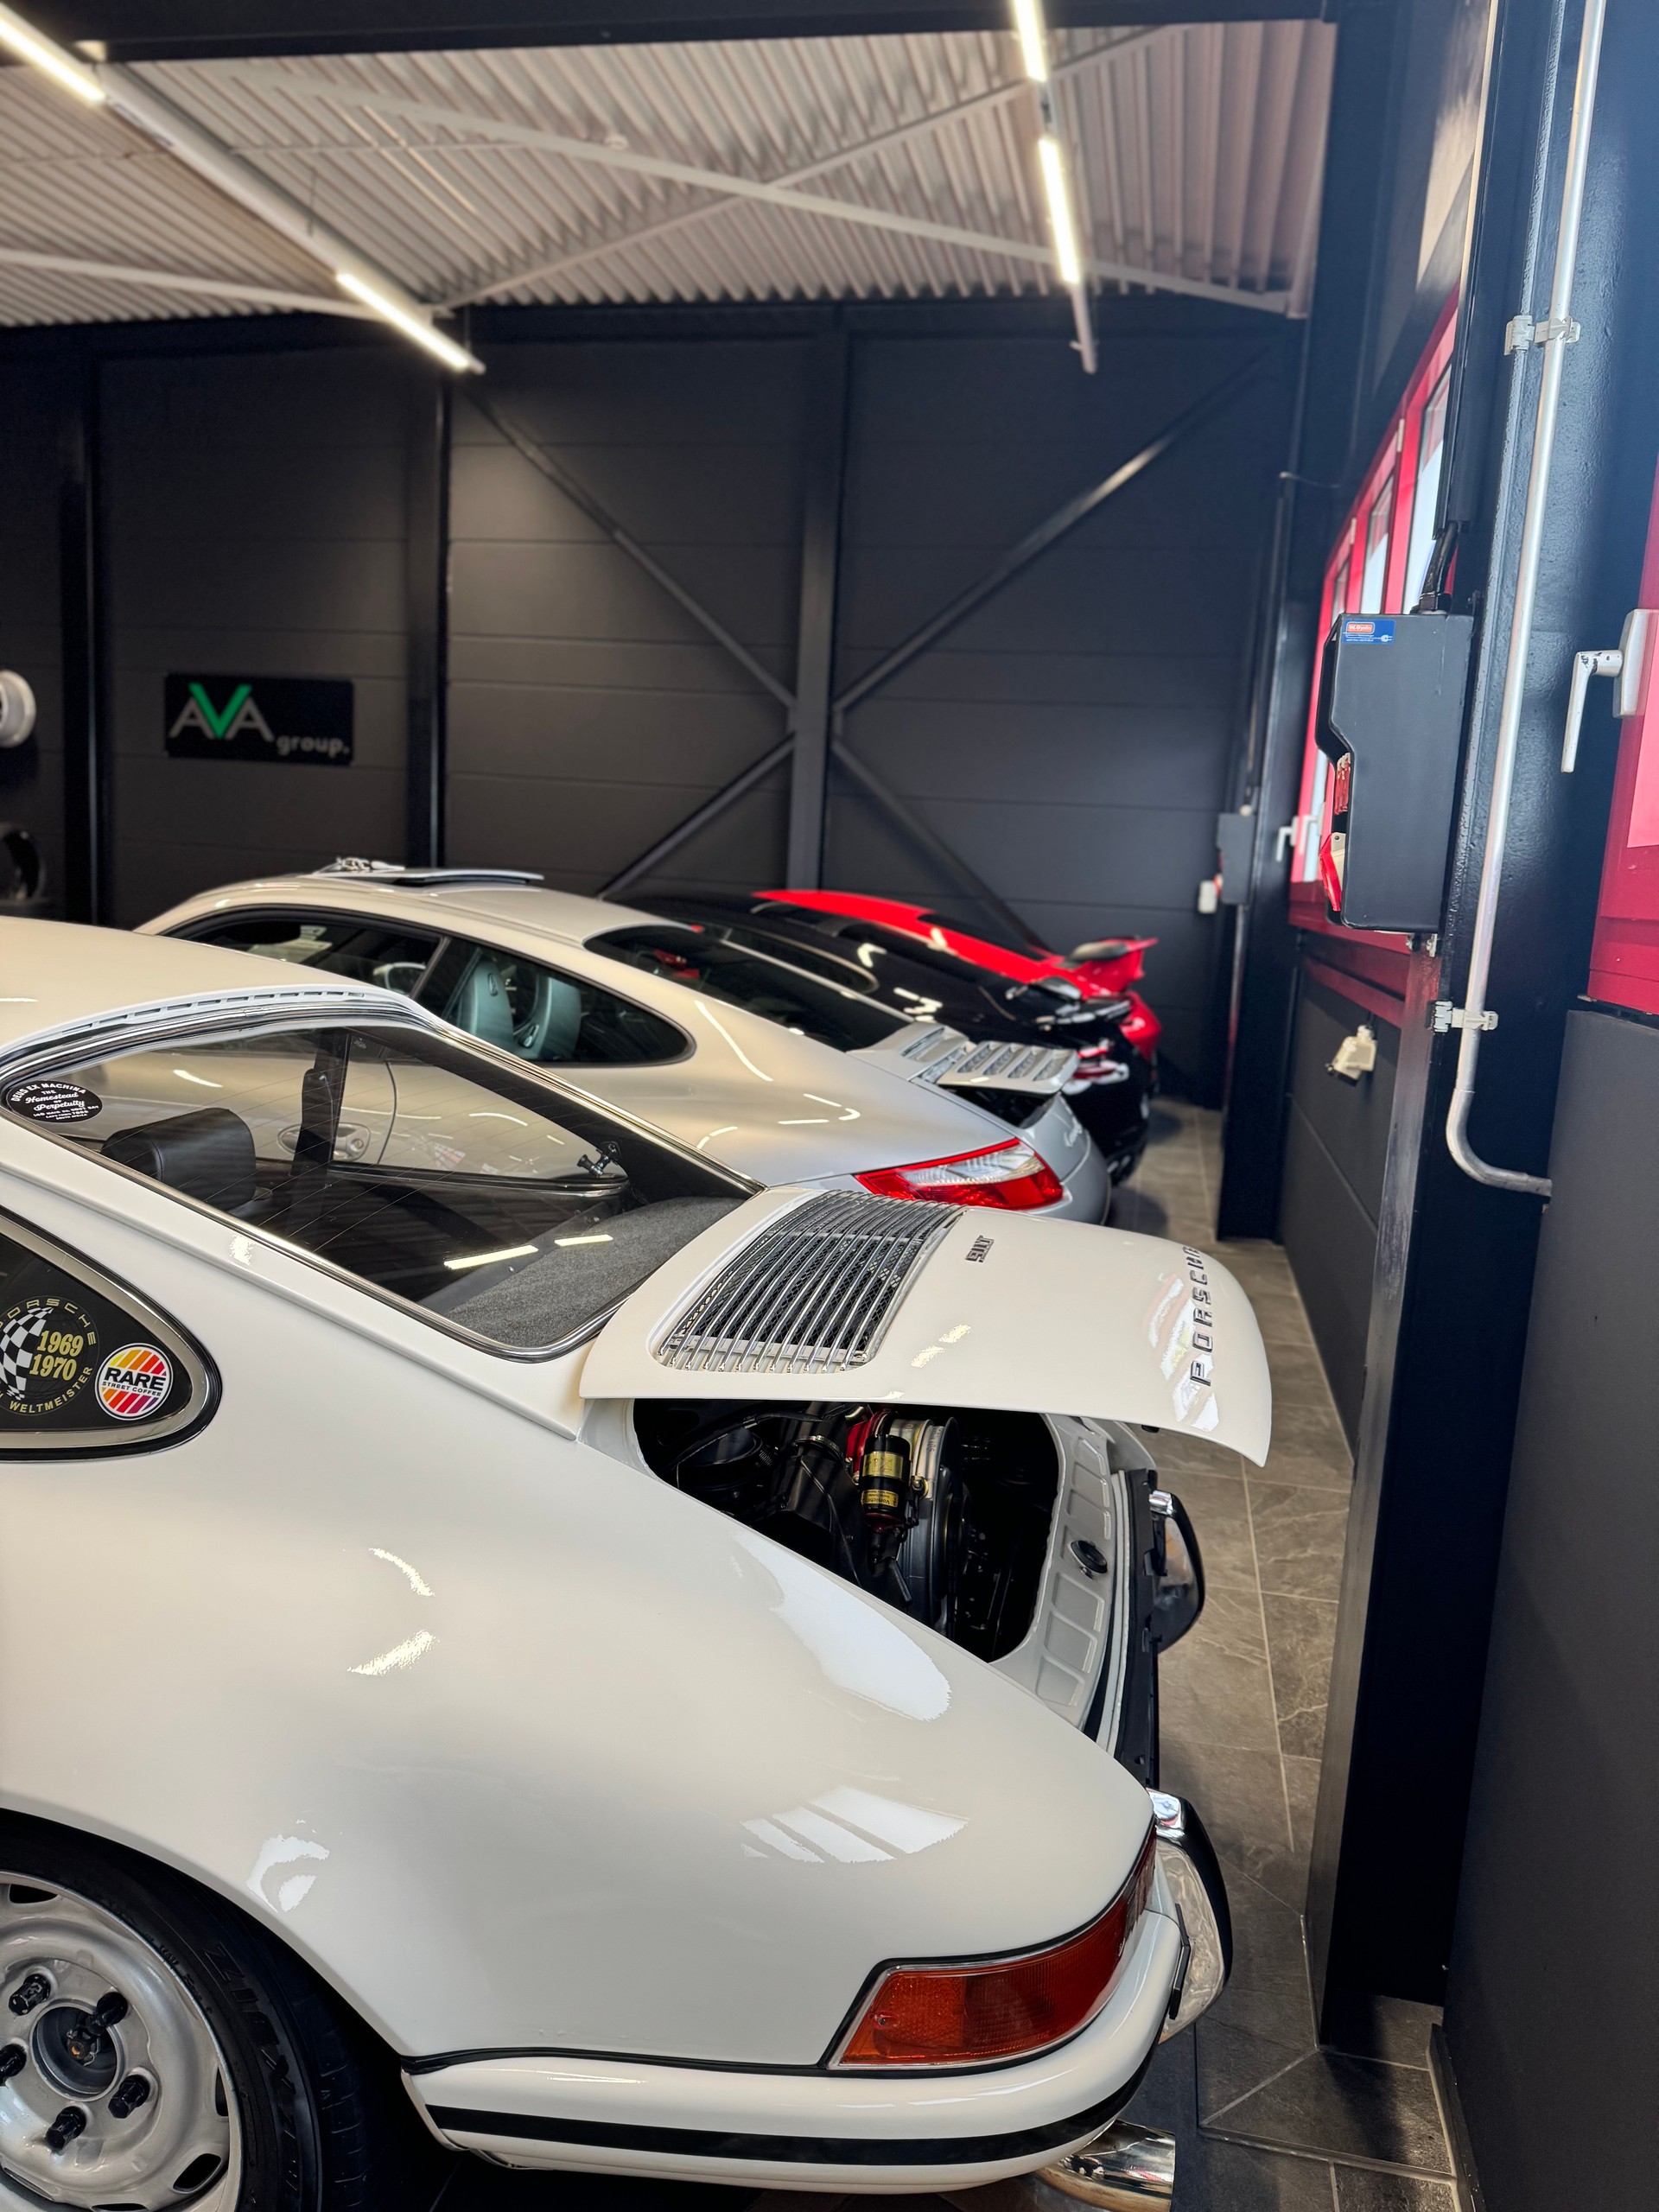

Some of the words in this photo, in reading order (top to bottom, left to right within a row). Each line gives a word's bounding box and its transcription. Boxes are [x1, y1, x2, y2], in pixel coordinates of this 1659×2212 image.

[168, 682, 275, 742] AVA
[276, 735, 350, 758] group.
[11, 1088, 29, 1102] DEUS
[41, 1083, 86, 1094] MACHINA
[25, 1092, 79, 1103] Homestead
[34, 1100, 85, 1111] Perpetuity
[36, 1330, 84, 1357] 1969
[29, 1354, 77, 1381] 1970
[105, 1367, 167, 1391] RARE
[9, 1366, 93, 1413] WELTMEISTER
[102, 1381, 130, 1390] STREET
[132, 1387, 162, 1396] COFFEE
